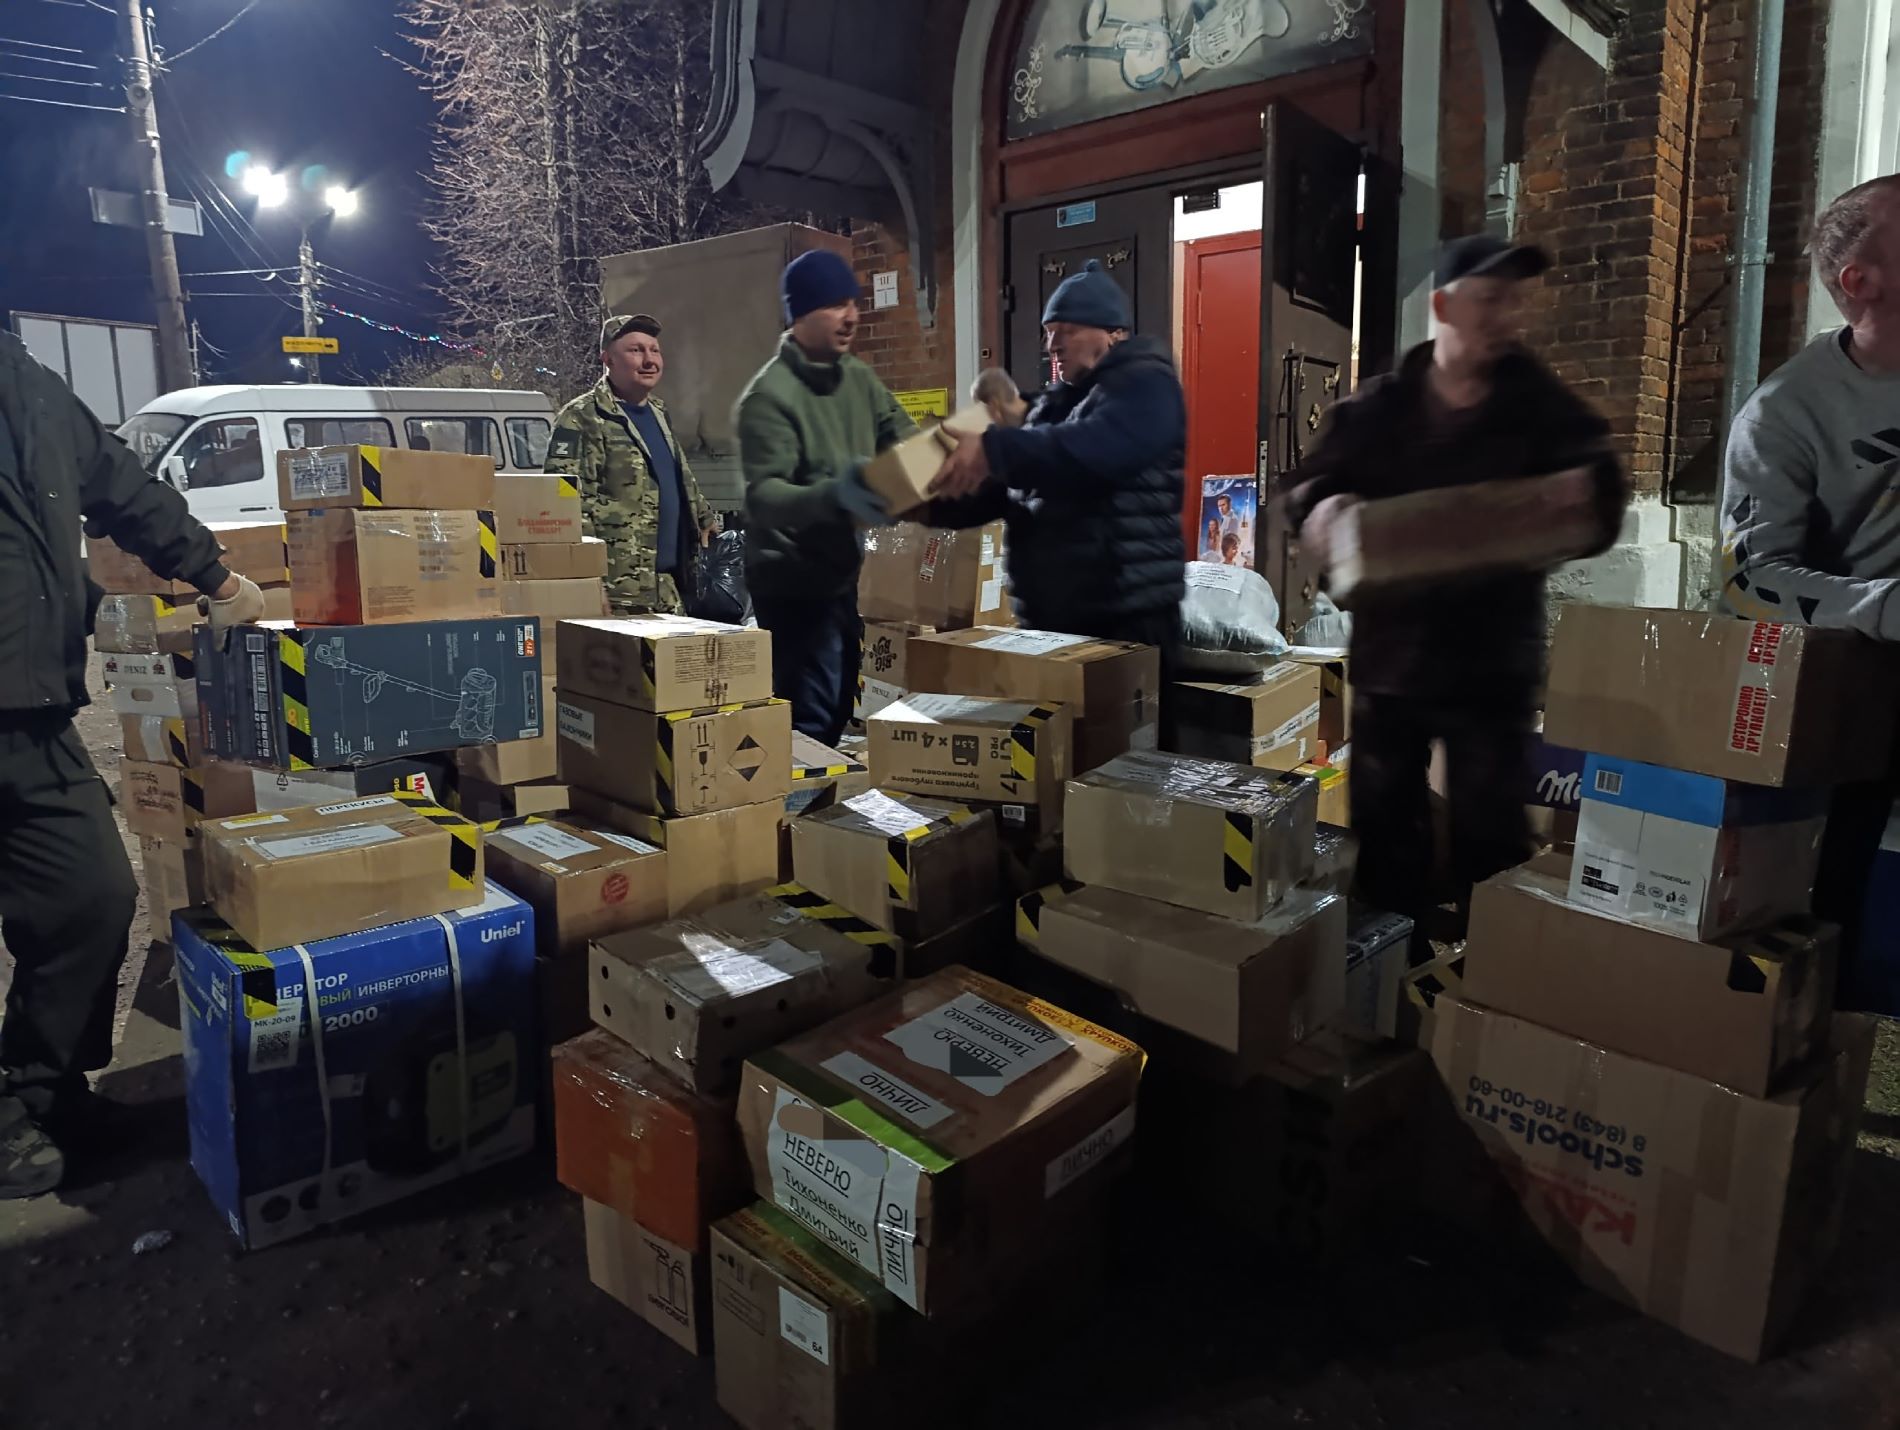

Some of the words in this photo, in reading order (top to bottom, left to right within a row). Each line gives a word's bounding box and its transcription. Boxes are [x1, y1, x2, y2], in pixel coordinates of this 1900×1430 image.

[1747, 623, 1768, 664] ОСТОРО
[922, 732, 935, 748] 4
[1731, 686, 1754, 750] ОСТОРОЖНО
[1745, 686, 1767, 753] ХРУПКОЕ!!!
[319, 799, 386, 813] ПЕРЕКУСЫ
[480, 920, 523, 944] Uniel
[358, 964, 449, 997] ИНВЕРТОРНЫ
[325, 1006, 379, 1033] 2000
[943, 1007, 1036, 1056] Тихоненко
[975, 1001, 1058, 1045] Дмитрий
[860, 1070, 931, 1115] ЛИЧНО
[1465, 1097, 1644, 1178] schools.ru
[1573, 1110, 1626, 1146] (843)
[1632, 1133, 1647, 1154] 8
[783, 1132, 851, 1194] НЕВЕРЮ
[1059, 1129, 1114, 1178] ЛИЧНО
[783, 1166, 869, 1240] Тихоненко
[789, 1196, 862, 1263] Дмитрий
[886, 1201, 908, 1284] ЛИЧНО
